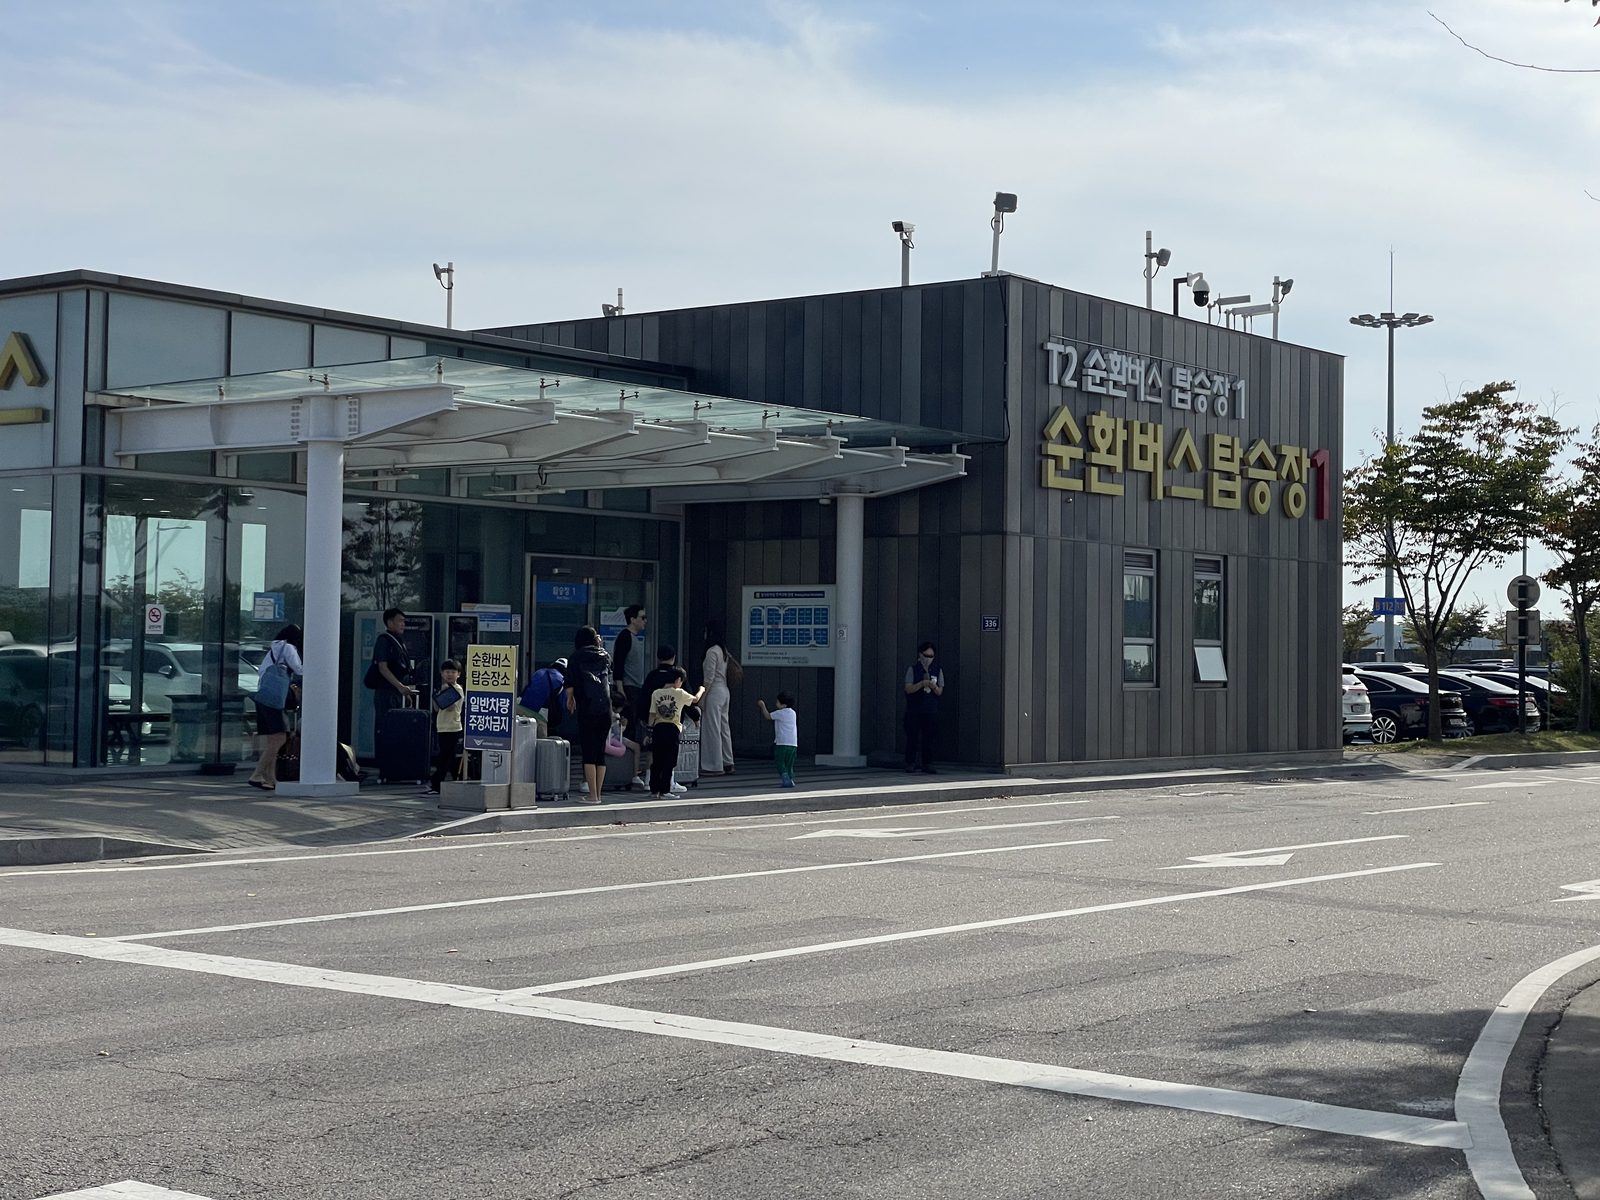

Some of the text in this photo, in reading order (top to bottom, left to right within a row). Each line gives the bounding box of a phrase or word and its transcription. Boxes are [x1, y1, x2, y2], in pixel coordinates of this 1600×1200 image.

[1043, 341, 1077, 388] T2
[1082, 348, 1163, 403] 순환버스
[984, 619, 997, 628] 336
[472, 652, 511, 667] 순환버스
[471, 671, 510, 686] 탑승장소
[469, 696, 510, 714] 일반차량
[468, 715, 509, 732] 주정차금지
